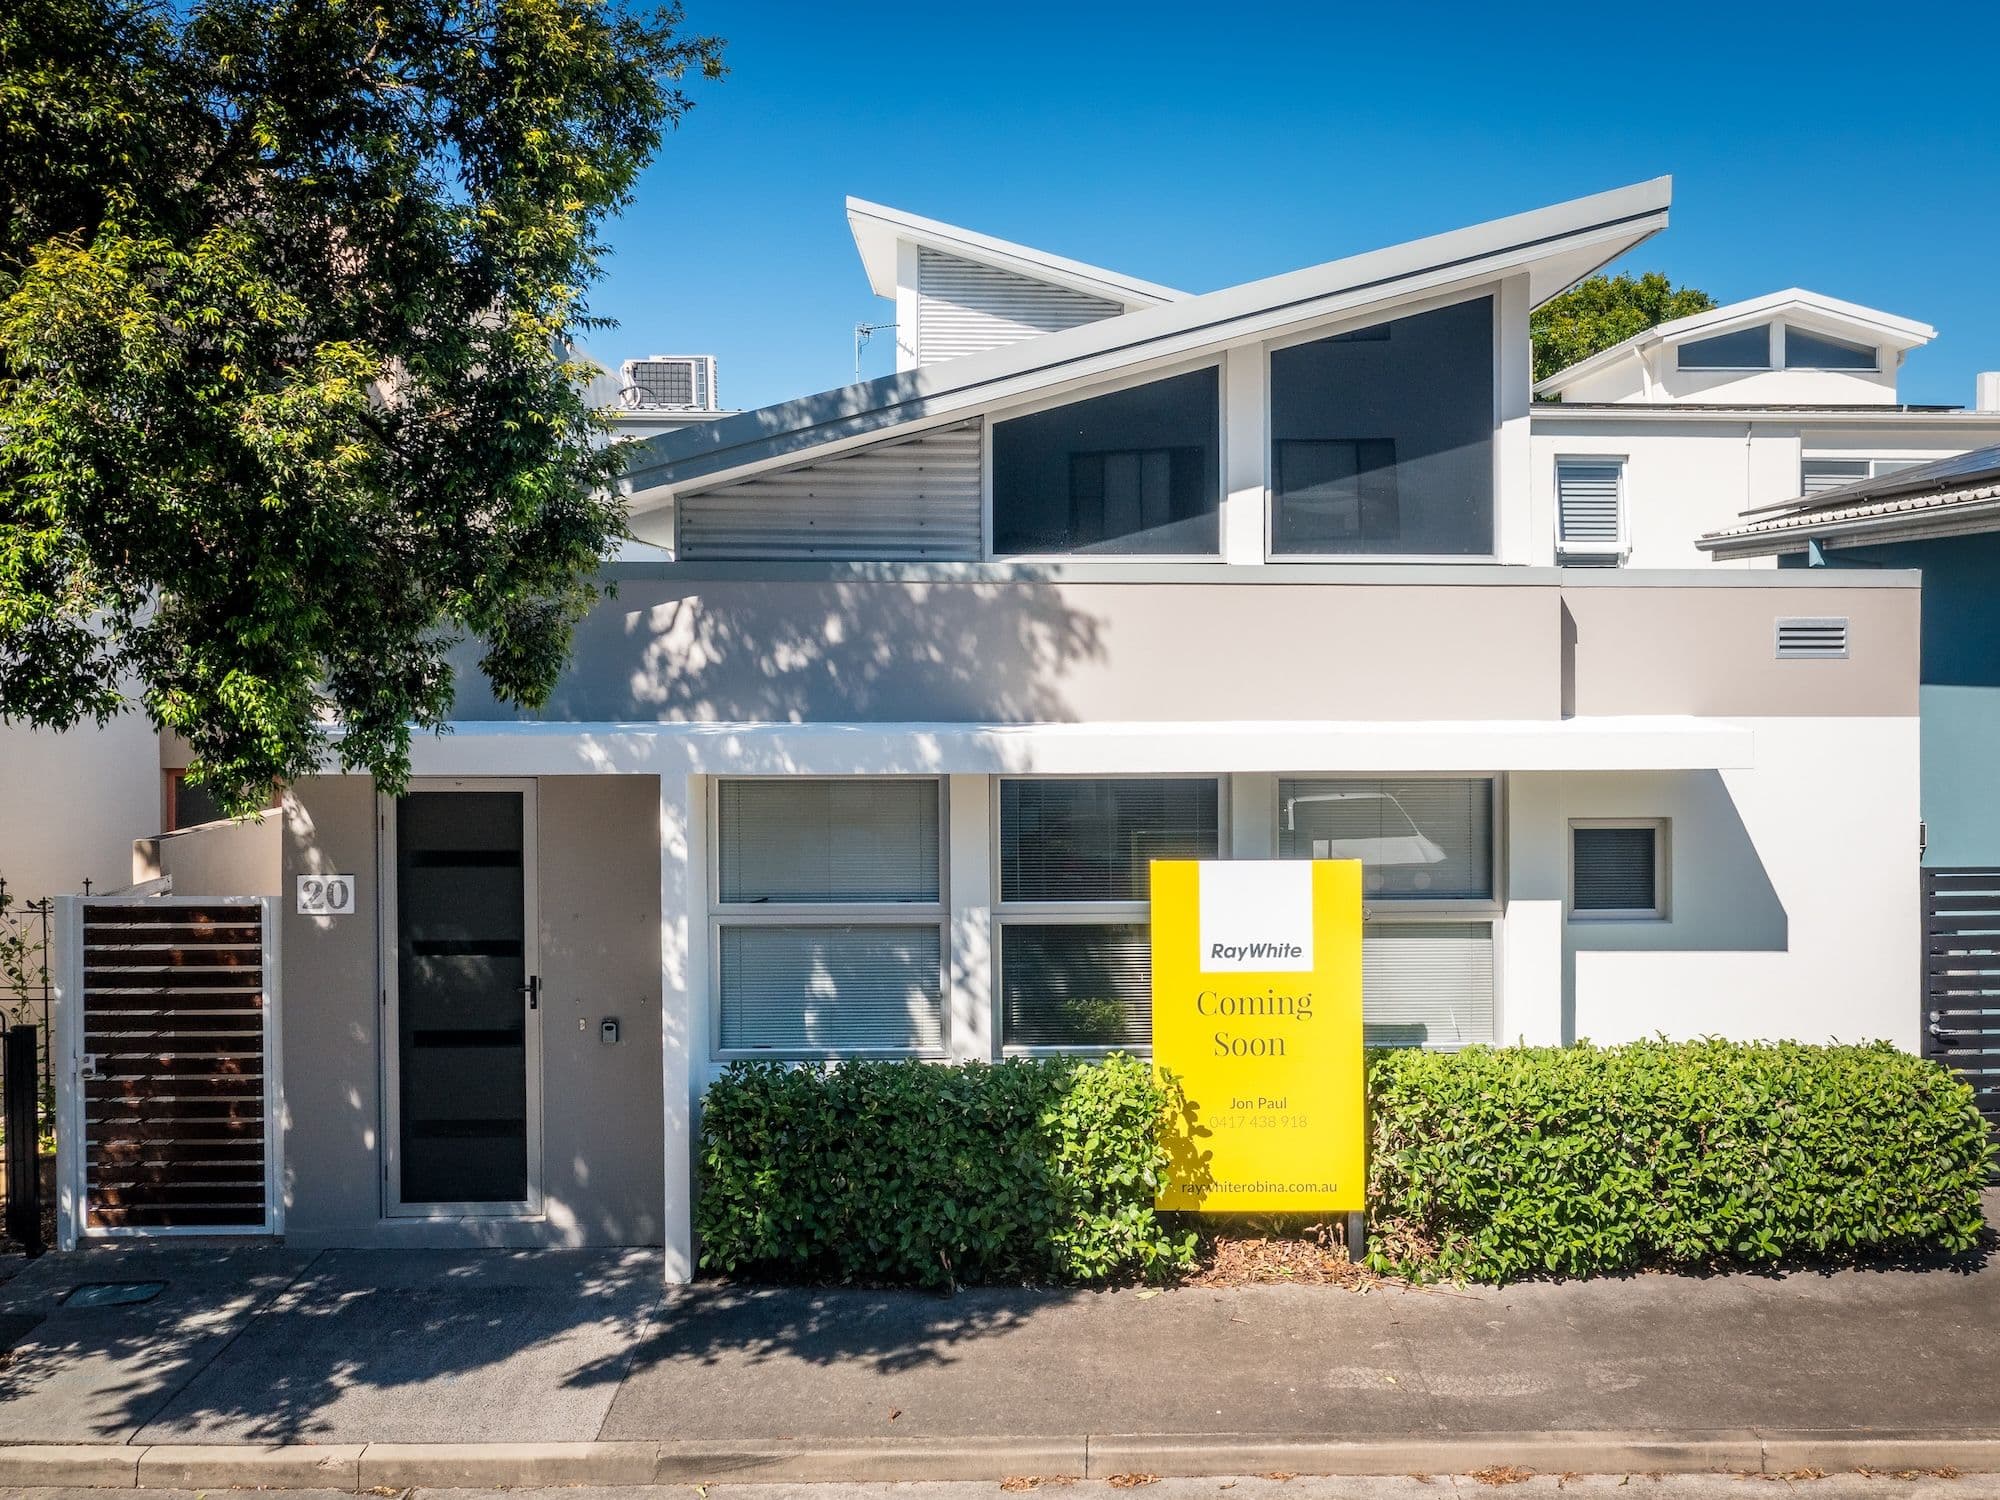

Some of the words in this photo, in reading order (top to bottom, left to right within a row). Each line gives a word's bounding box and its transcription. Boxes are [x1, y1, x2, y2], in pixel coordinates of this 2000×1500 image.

[302, 880, 349, 909] 20
[1196, 989, 1313, 1022] Coming
[1213, 1031, 1287, 1058] Soon
[1229, 1097, 1254, 1110] Jon
[1258, 1097, 1287, 1110] Paul
[1209, 1115, 1246, 1128] 0417
[1250, 1115, 1277, 1128] 438
[1281, 1115, 1308, 1128] 918
[1181, 1180, 1338, 1196] raywhiterobina.com.au
